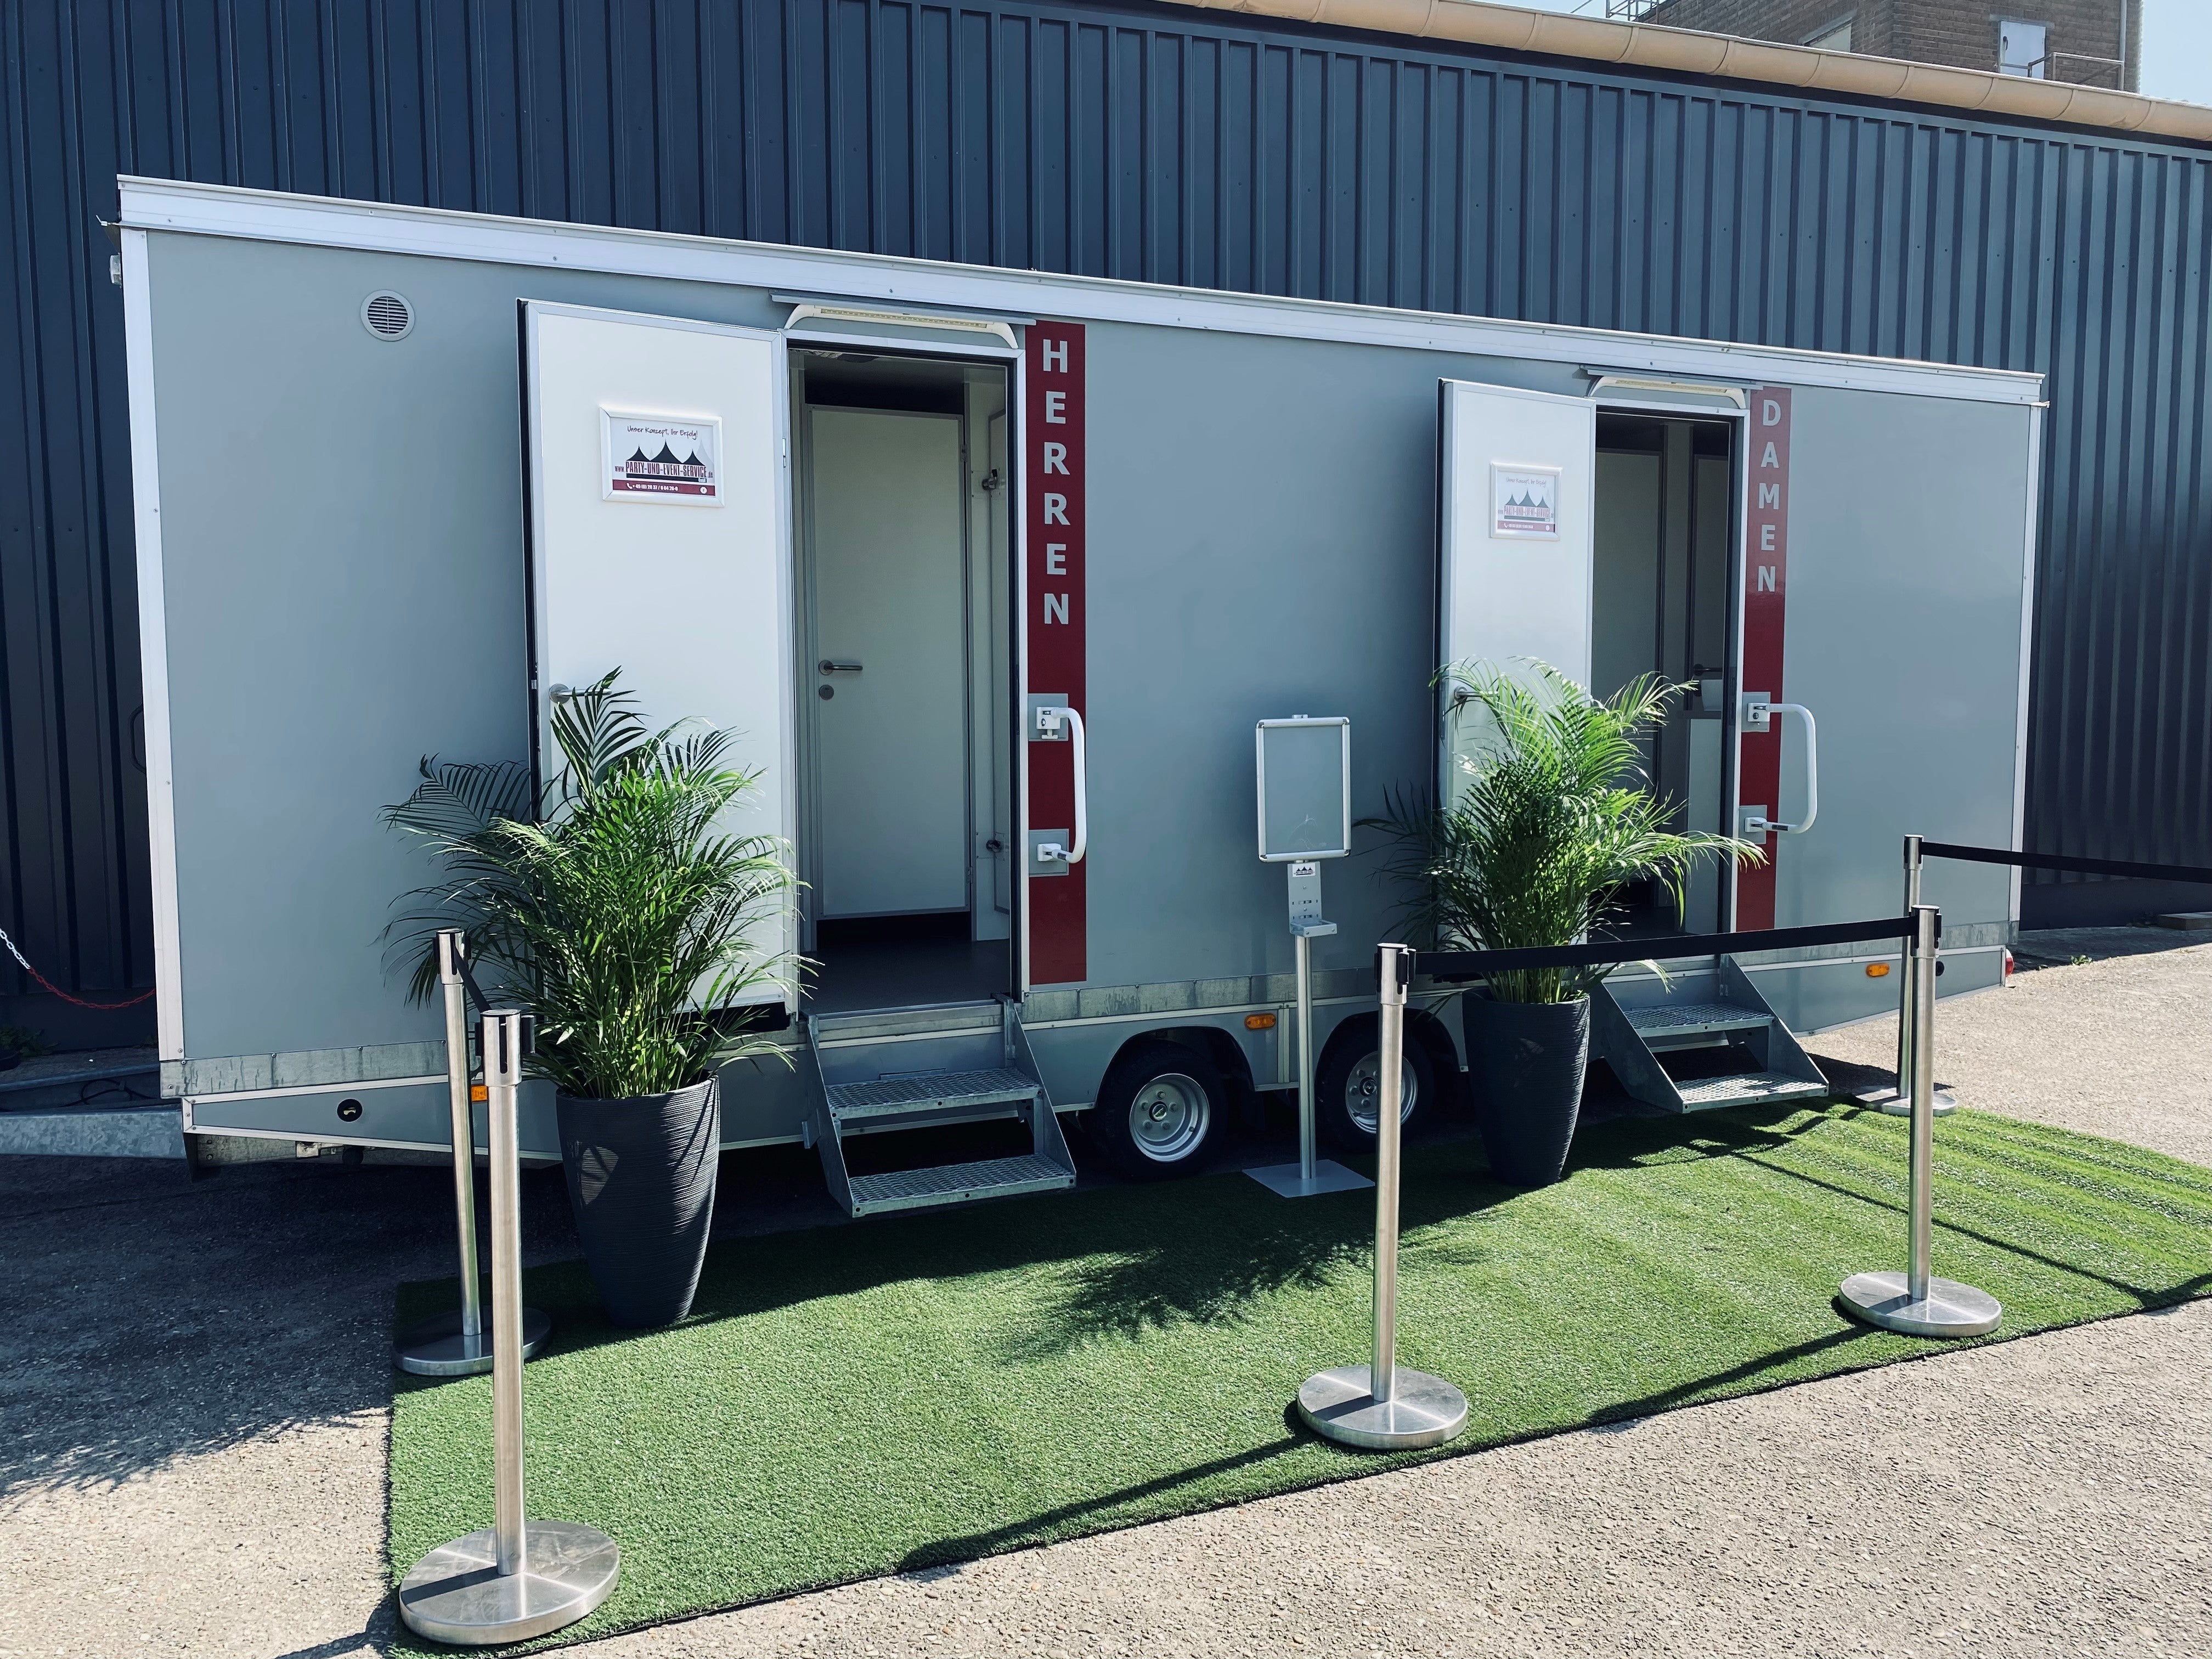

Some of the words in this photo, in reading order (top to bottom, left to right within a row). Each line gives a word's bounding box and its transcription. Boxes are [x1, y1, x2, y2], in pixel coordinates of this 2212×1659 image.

[680, 430, 698, 440] Erfolg!
[1043, 338, 1070, 625] HERREN
[1758, 399, 1781, 592] DAMEN
